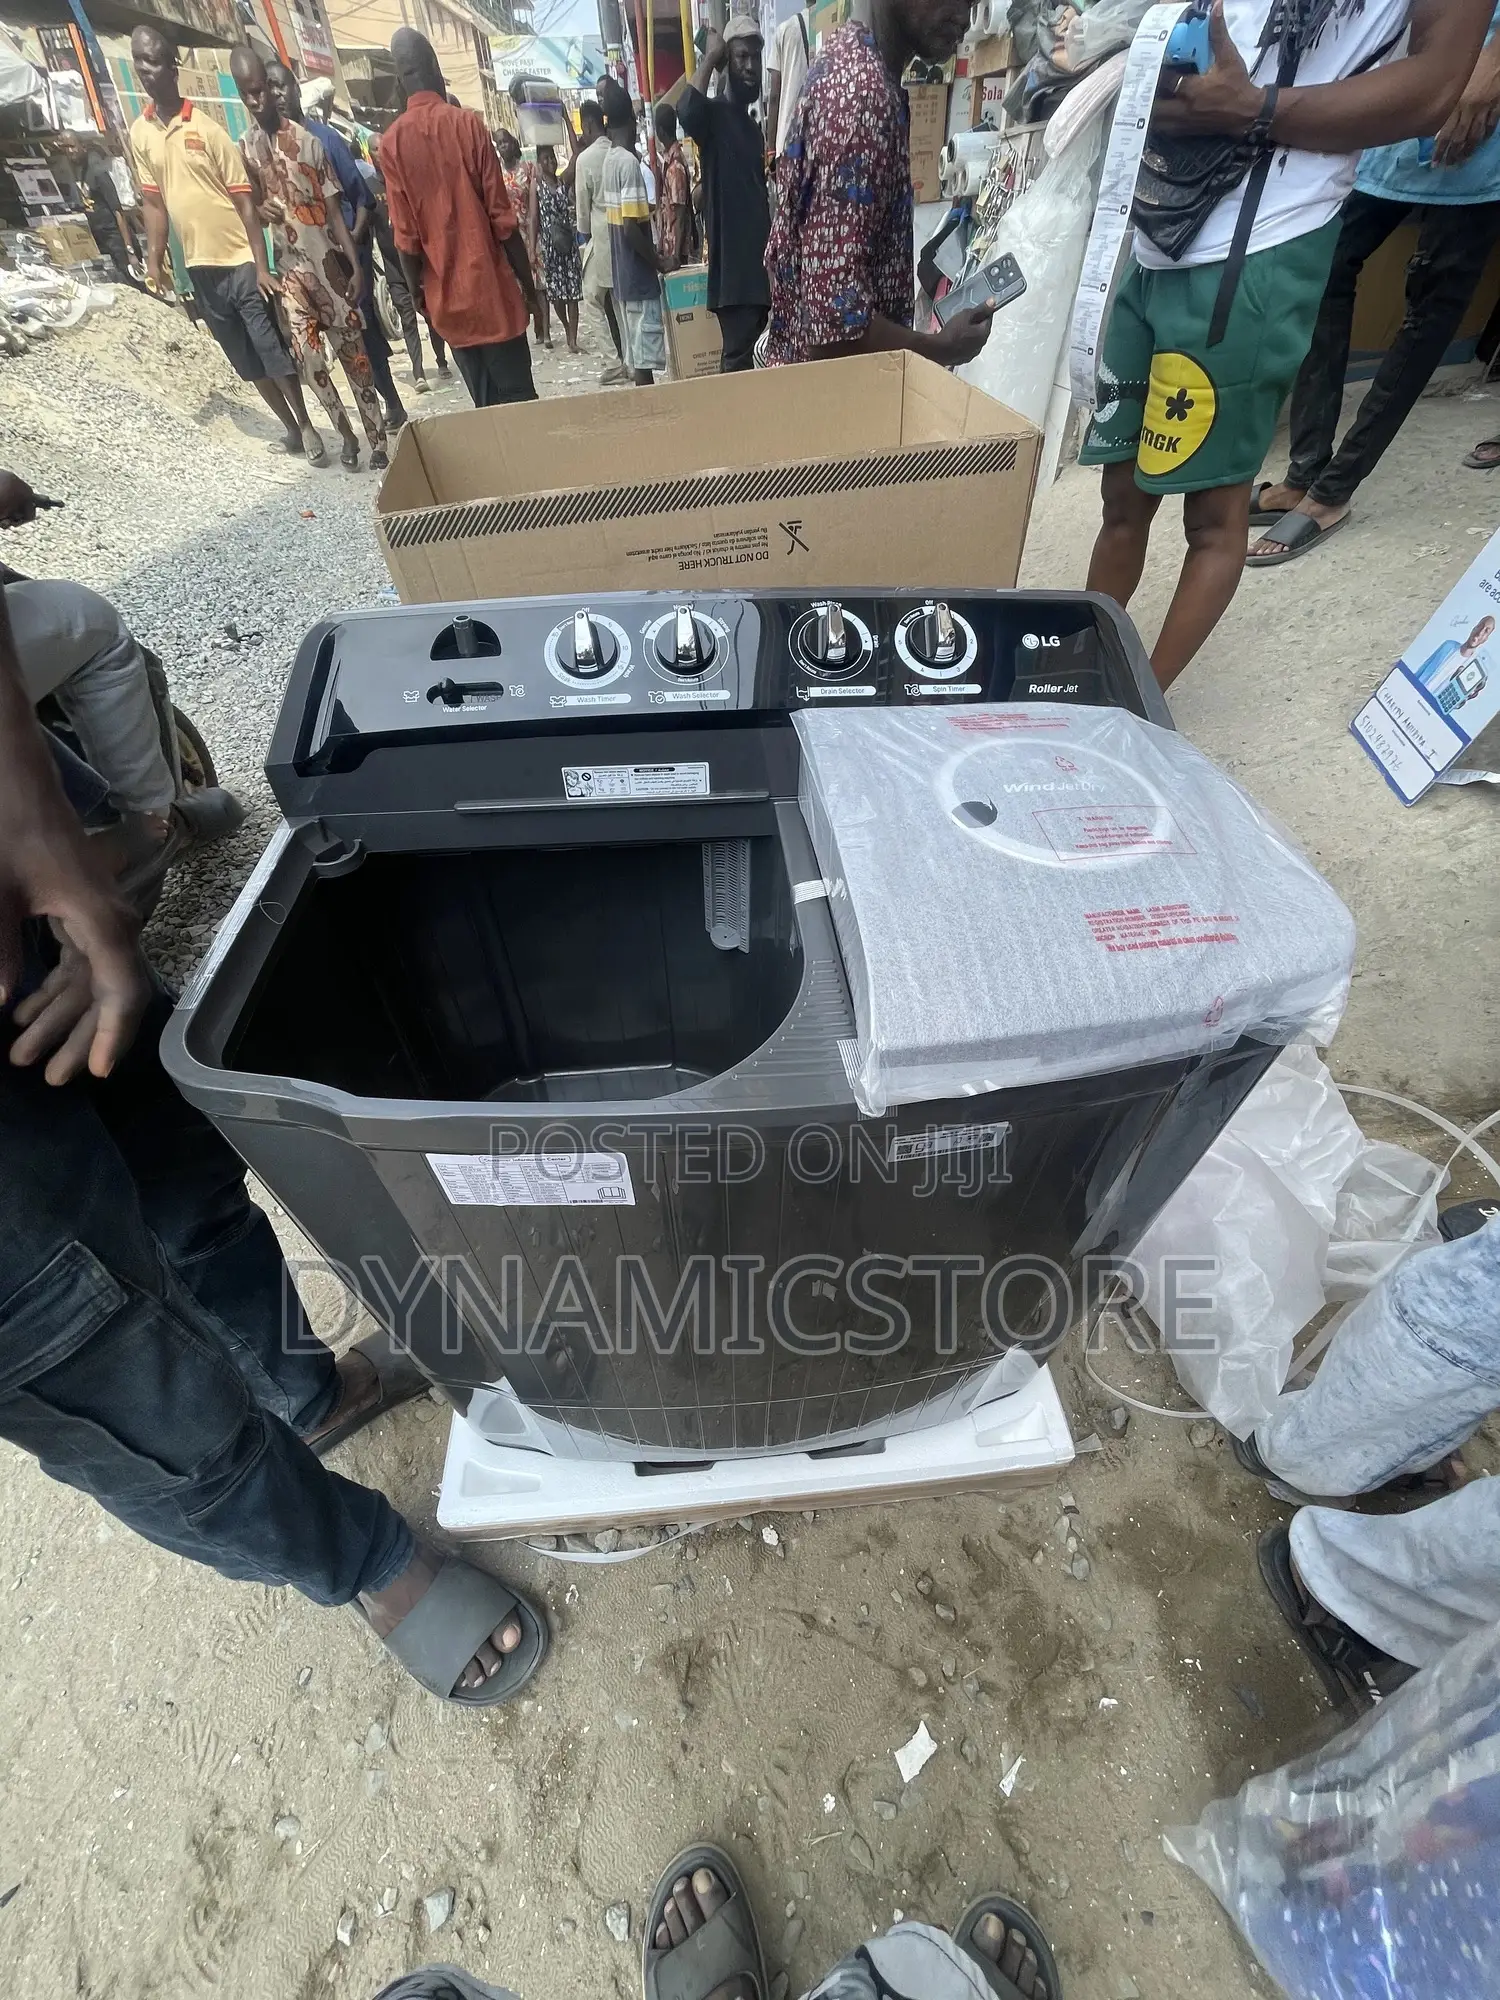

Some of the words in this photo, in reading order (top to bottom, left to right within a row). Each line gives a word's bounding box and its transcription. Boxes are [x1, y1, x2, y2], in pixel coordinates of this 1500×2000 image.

[981, 85, 1004, 100] Sola
[704, 555, 735, 568] TRUCK
[735, 553, 754, 564] NOT
[755, 551, 769, 561] DO
[678, 560, 703, 571] HERE
[1028, 684, 1063, 694] Roller
[1064, 684, 1079, 694] Jet
[442, 705, 461, 713] Water
[1003, 782, 1055, 793] Wind
